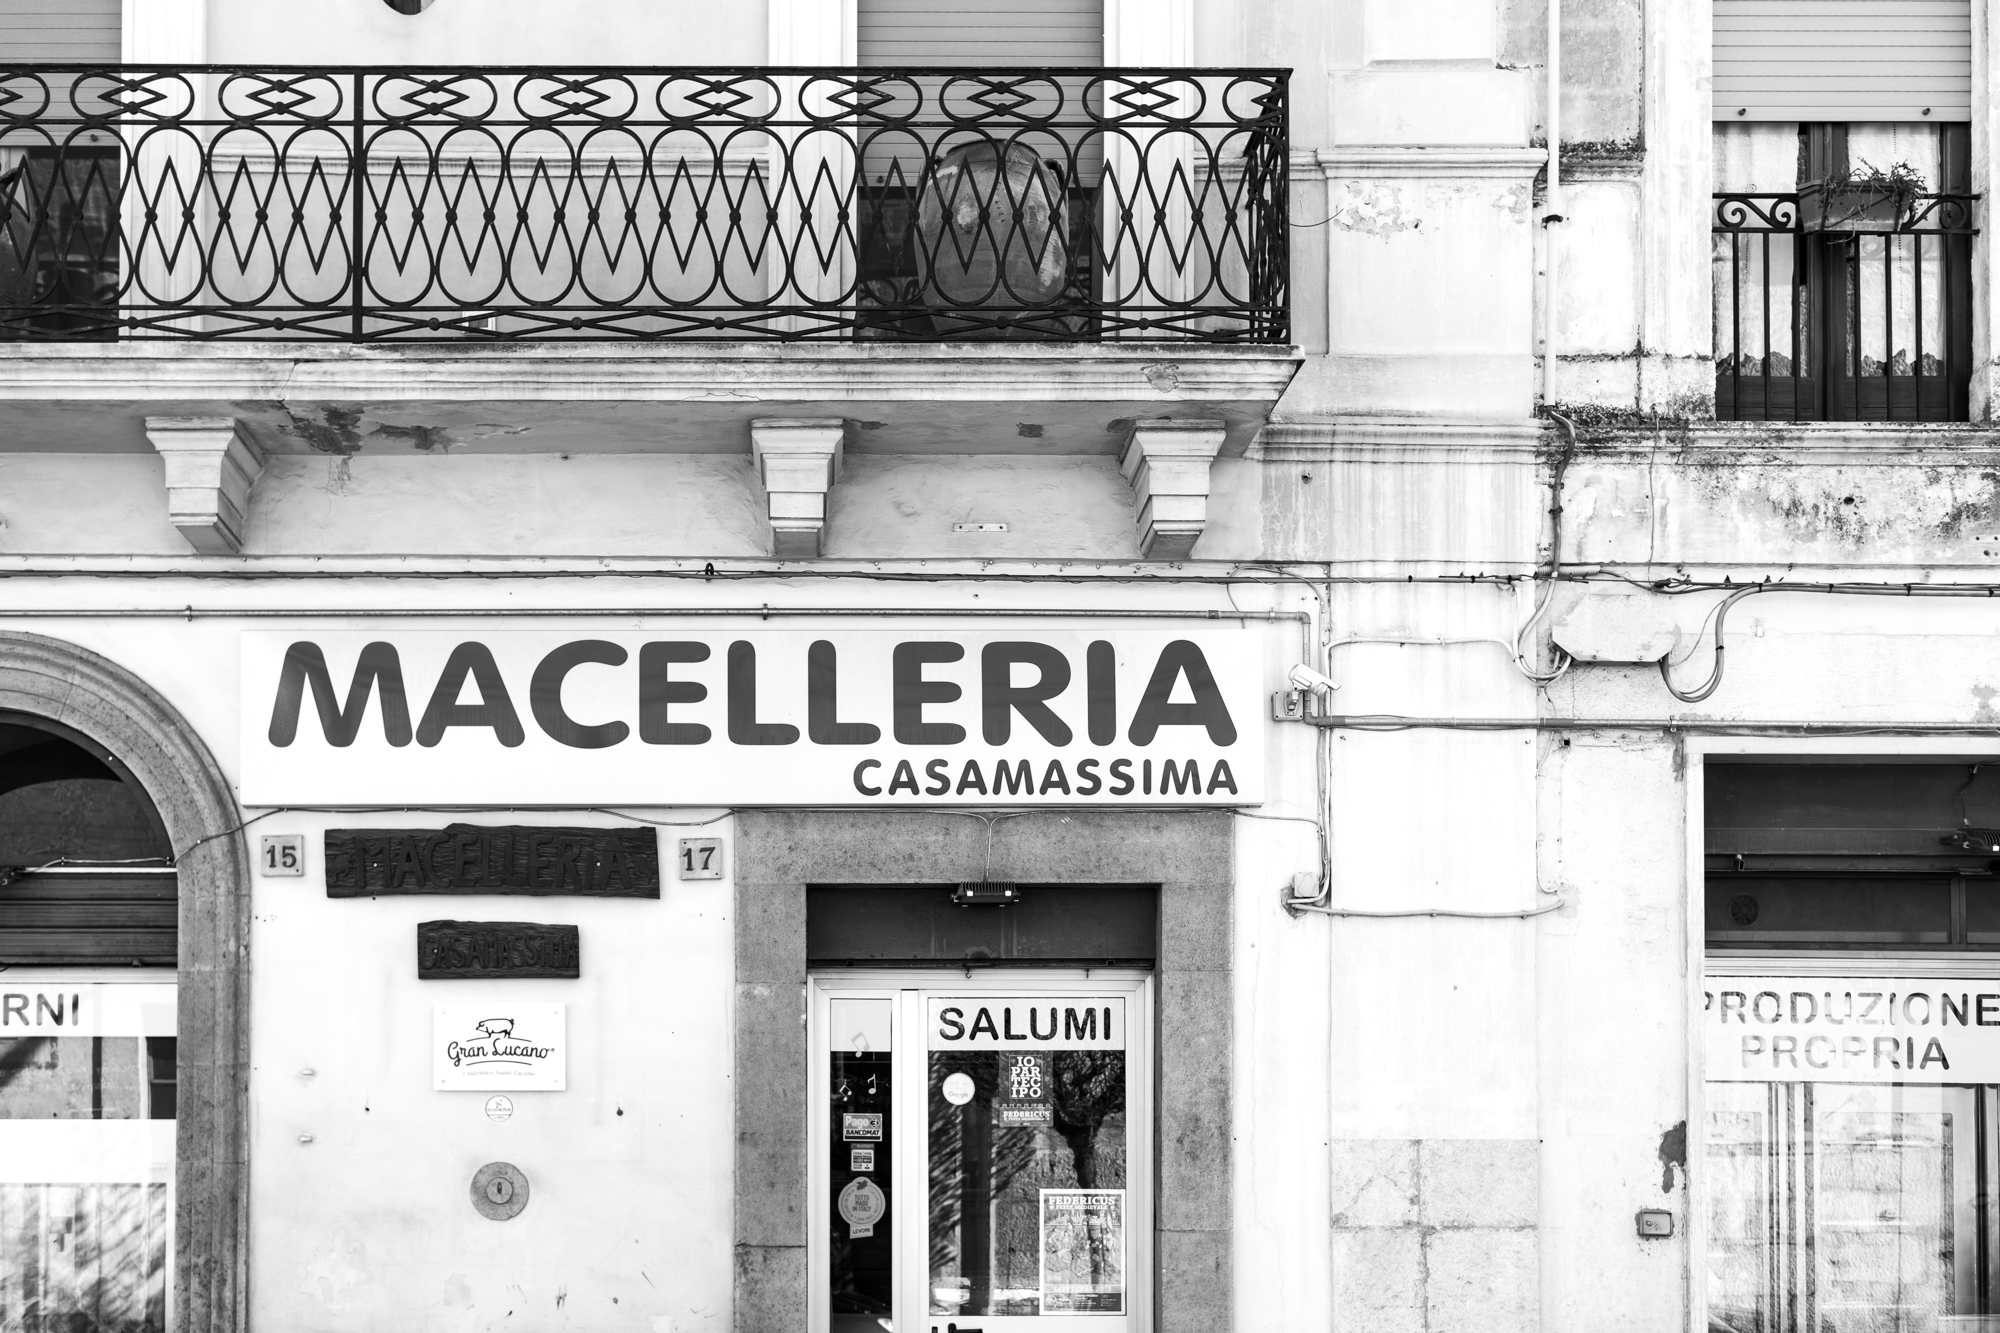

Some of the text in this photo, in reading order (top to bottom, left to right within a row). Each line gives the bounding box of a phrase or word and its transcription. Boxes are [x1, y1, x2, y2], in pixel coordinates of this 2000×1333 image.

[268, 639, 1238, 750] MACELLERIA
[853, 758, 1238, 797] CASAMASSIMA
[266, 845, 297, 868] 15
[683, 847, 716, 871] 17
[939, 1006, 1111, 1041] SALUMI
[447, 1037, 550, 1067] Gran Lucano
[1741, 1035, 1951, 1071] PROPRIA
[1016, 1056, 1035, 1067] IO
[1010, 1066, 1041, 1077] PAR
[1010, 1076, 1042, 1088] TEC
[1011, 1087, 1042, 1098] IPO
[845, 1115, 869, 1129] Pago
[1003, 1110, 1051, 1118] FEDERICUS
[1048, 1196, 1116, 1205] FEDERICUS
